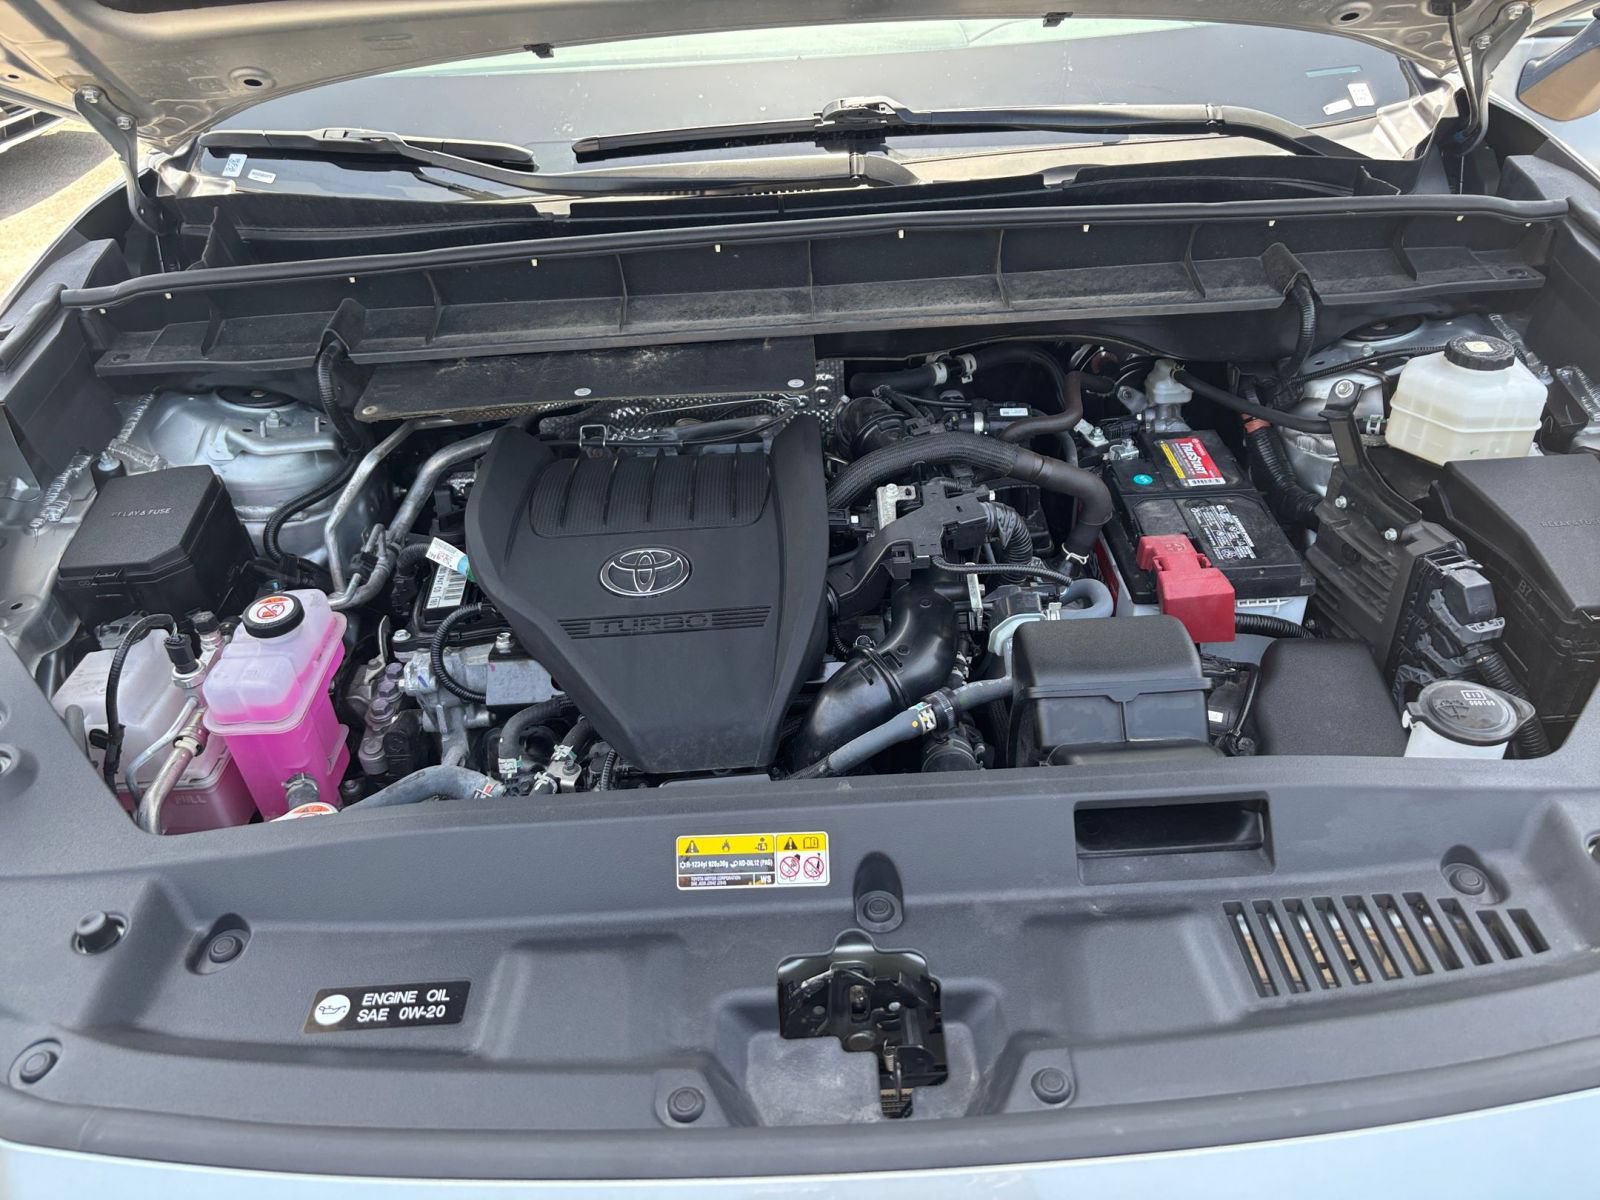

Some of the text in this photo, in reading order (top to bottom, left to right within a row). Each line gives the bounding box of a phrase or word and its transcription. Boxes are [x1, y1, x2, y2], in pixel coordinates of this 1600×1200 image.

[593, 614, 708, 633] TURBO
[760, 875, 772, 884] WS
[361, 988, 450, 1006] ENGINE OIL
[356, 1004, 446, 1022] SAE 0W-20
